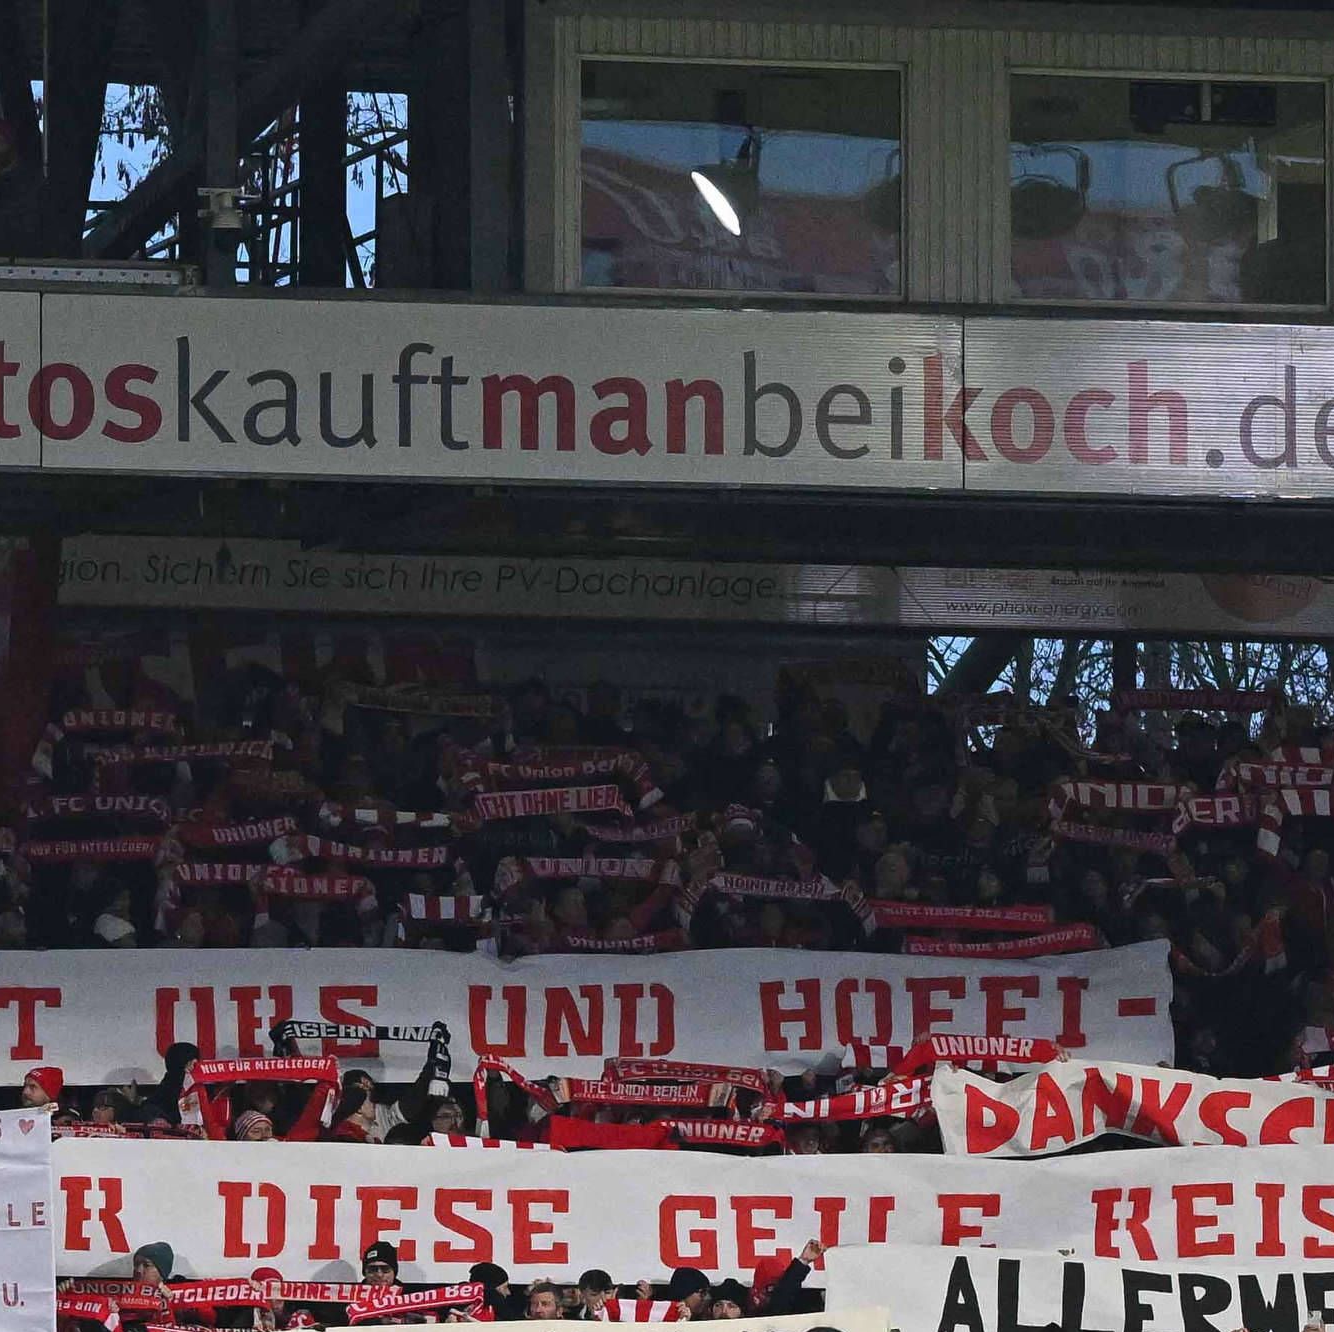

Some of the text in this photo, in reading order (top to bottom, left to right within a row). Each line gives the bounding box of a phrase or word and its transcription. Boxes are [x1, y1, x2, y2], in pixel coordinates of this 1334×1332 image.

[282, 560, 331, 589] Sie
[342, 558, 409, 591] sich
[422, 558, 482, 592] Ihre
[495, 566, 783, 604] PV-Dachanlage.
[468, 983, 675, 1059] UND
[760, 976, 1156, 1051] HOFFI-
[201, 1058, 331, 1075] NUR FÜR MITGLIEDER!
[932, 1035, 1033, 1058] UNIONER
[219, 1181, 569, 1264] DIESE
